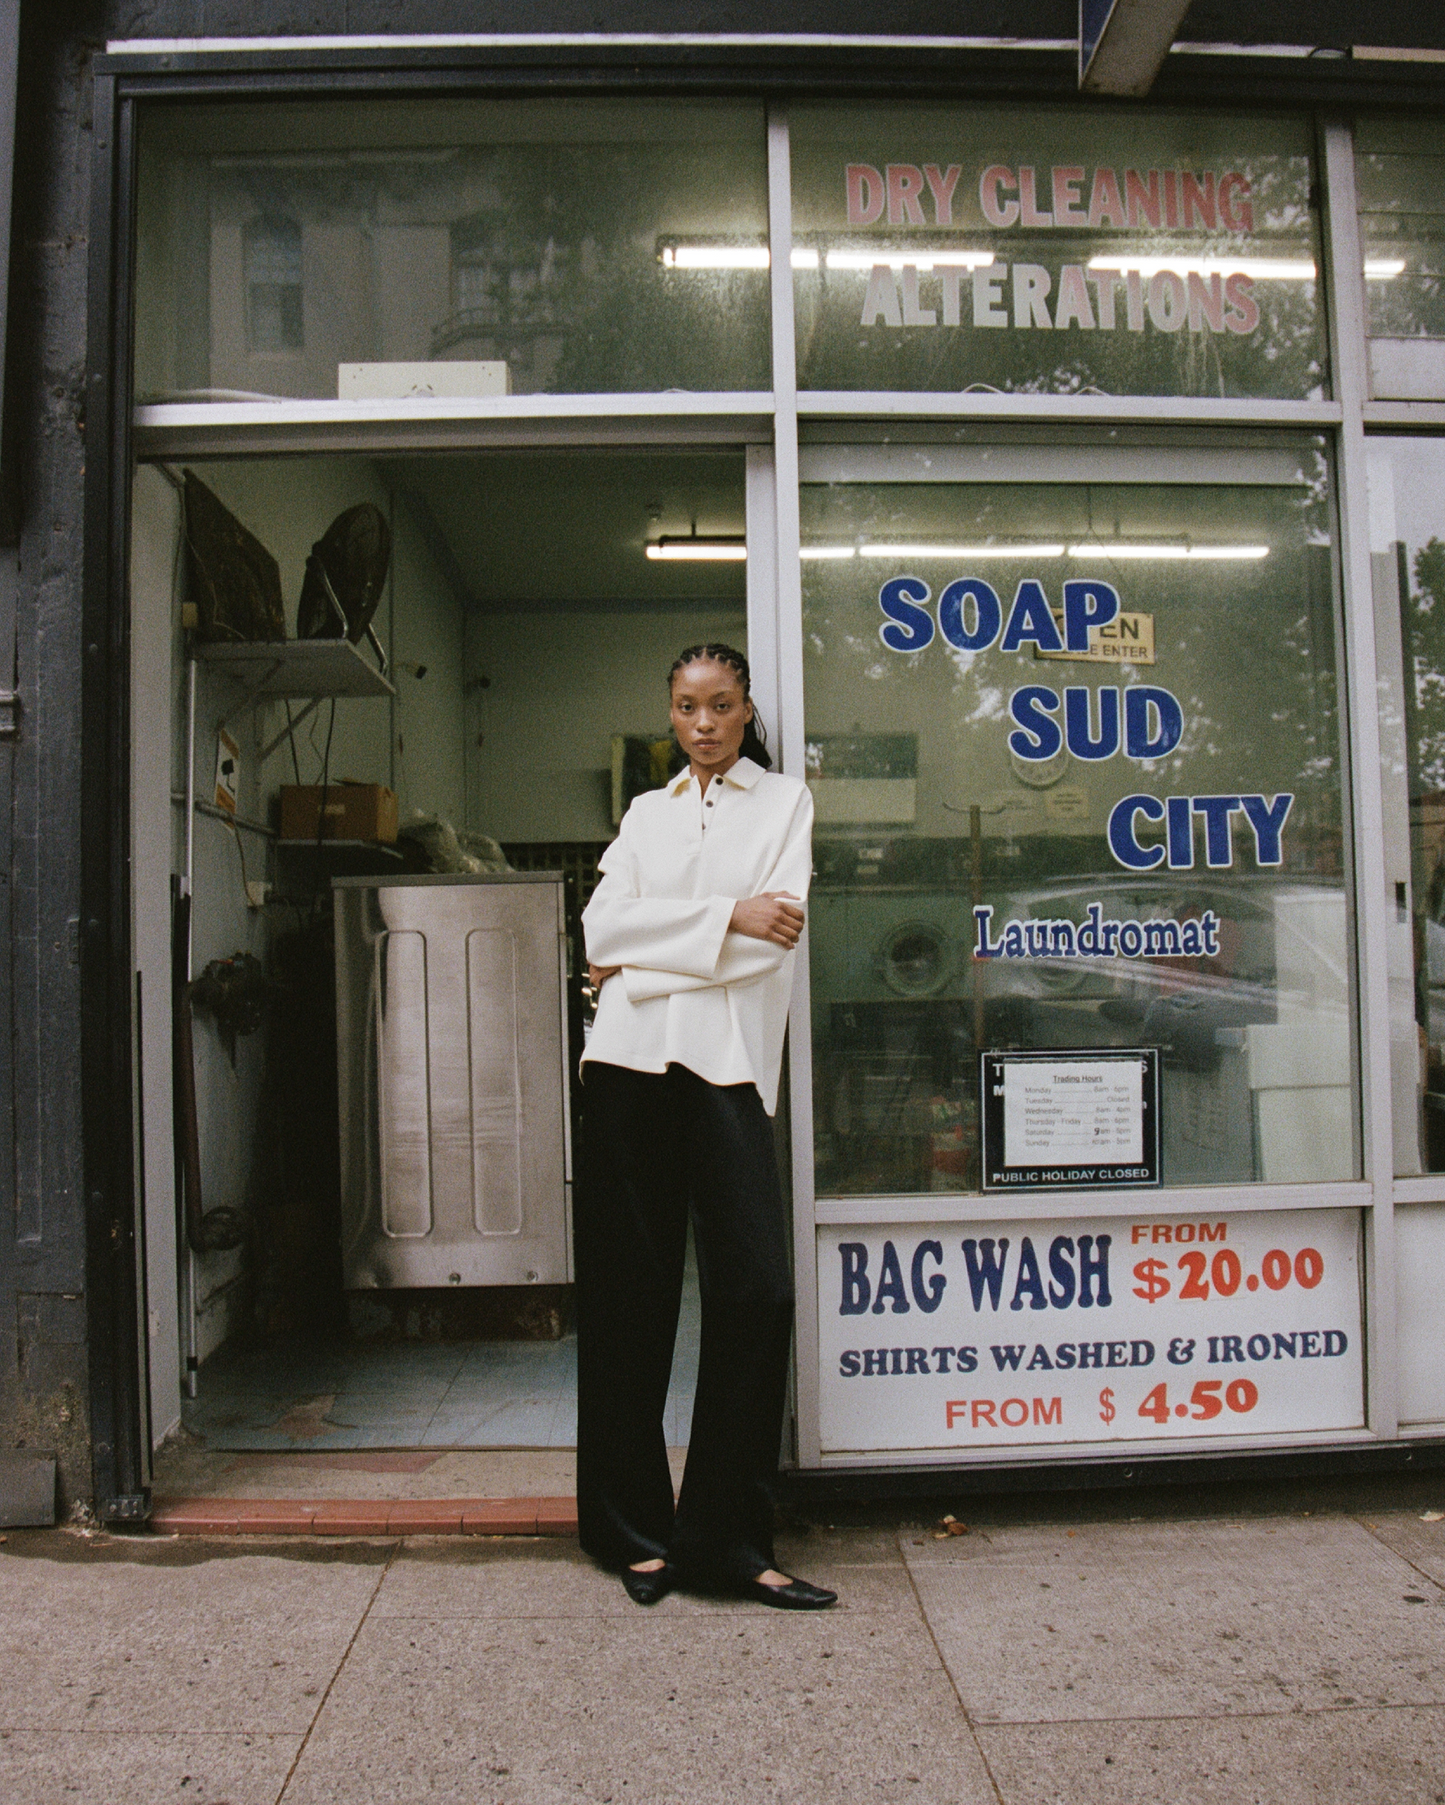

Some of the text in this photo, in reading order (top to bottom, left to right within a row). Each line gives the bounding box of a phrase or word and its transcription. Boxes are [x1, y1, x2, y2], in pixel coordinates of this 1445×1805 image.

[845, 162, 1254, 232] DRY CLEANING
[860, 263, 1260, 335] ALTERATIONS
[878, 576, 1119, 652] SOAP
[1102, 644, 1148, 658] ENTER
[1008, 685, 1184, 762] SUD
[1107, 793, 1295, 870] CITY
[973, 902, 1221, 959] Laundromat
[1053, 1075, 1103, 1084] Trading Hours
[1025, 1097, 1053, 1105] Tuesday
[1025, 1107, 1064, 1115] Wednesday
[1025, 1118, 1056, 1126] Thursday
[1061, 1117, 1082, 1126] Friday
[1025, 1139, 1051, 1147] Sunday
[993, 1168, 1150, 1183] PUBLIC HOLIDAY CLOSED
[1131, 1222, 1228, 1245] FROM
[838, 1234, 1325, 1316] BAG WASH $20.00
[839, 1329, 1349, 1379] SHIRTS WASHED & IRONED
[945, 1396, 1064, 1429] FROM
